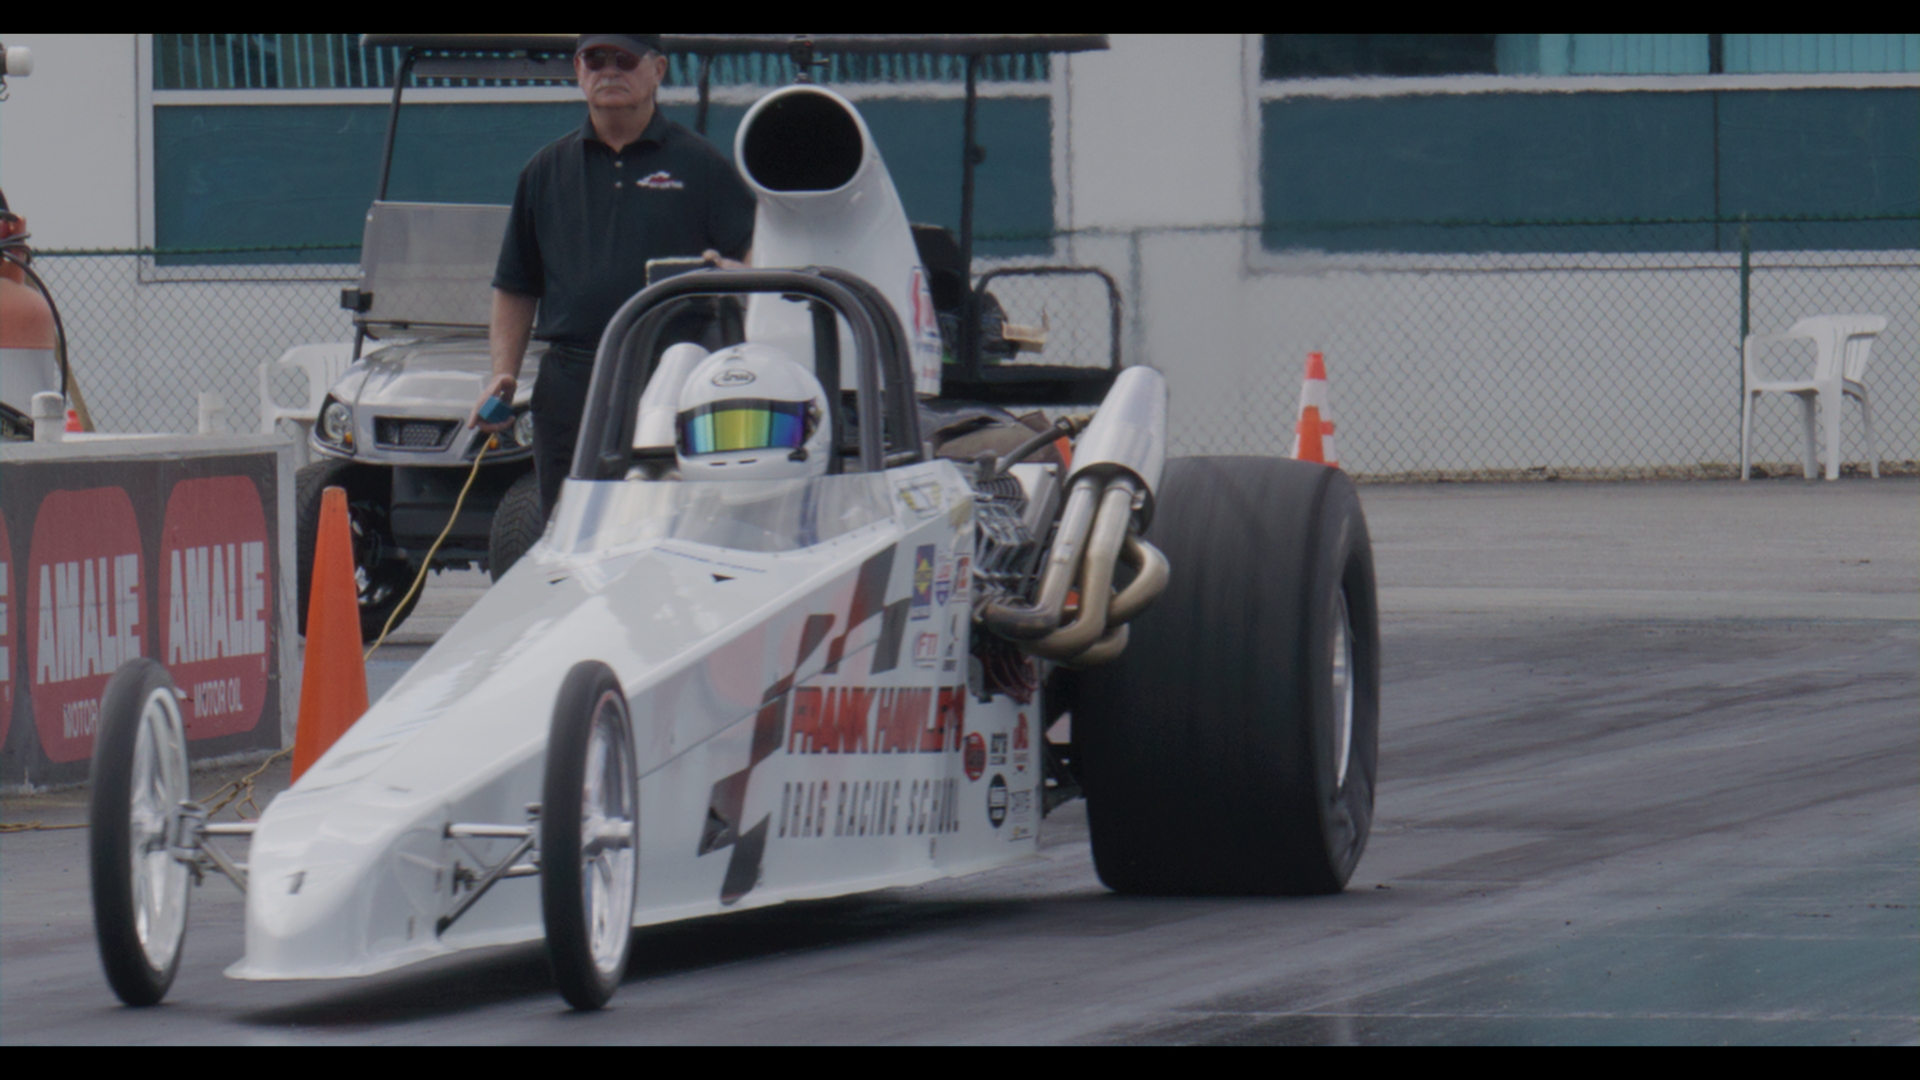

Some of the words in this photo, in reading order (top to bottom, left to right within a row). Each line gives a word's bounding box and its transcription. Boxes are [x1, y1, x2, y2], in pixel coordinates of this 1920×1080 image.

[37, 554, 141, 684] AMALIE
[168, 541, 266, 665] AMALIE
[63, 699, 99, 738] MOTOR
[193, 679, 227, 718] MOTOR
[228, 677, 243, 713] OIL
[786, 686, 876, 754] FRANK
[777, 779, 829, 838] DRAG
[834, 779, 900, 837] RACING
